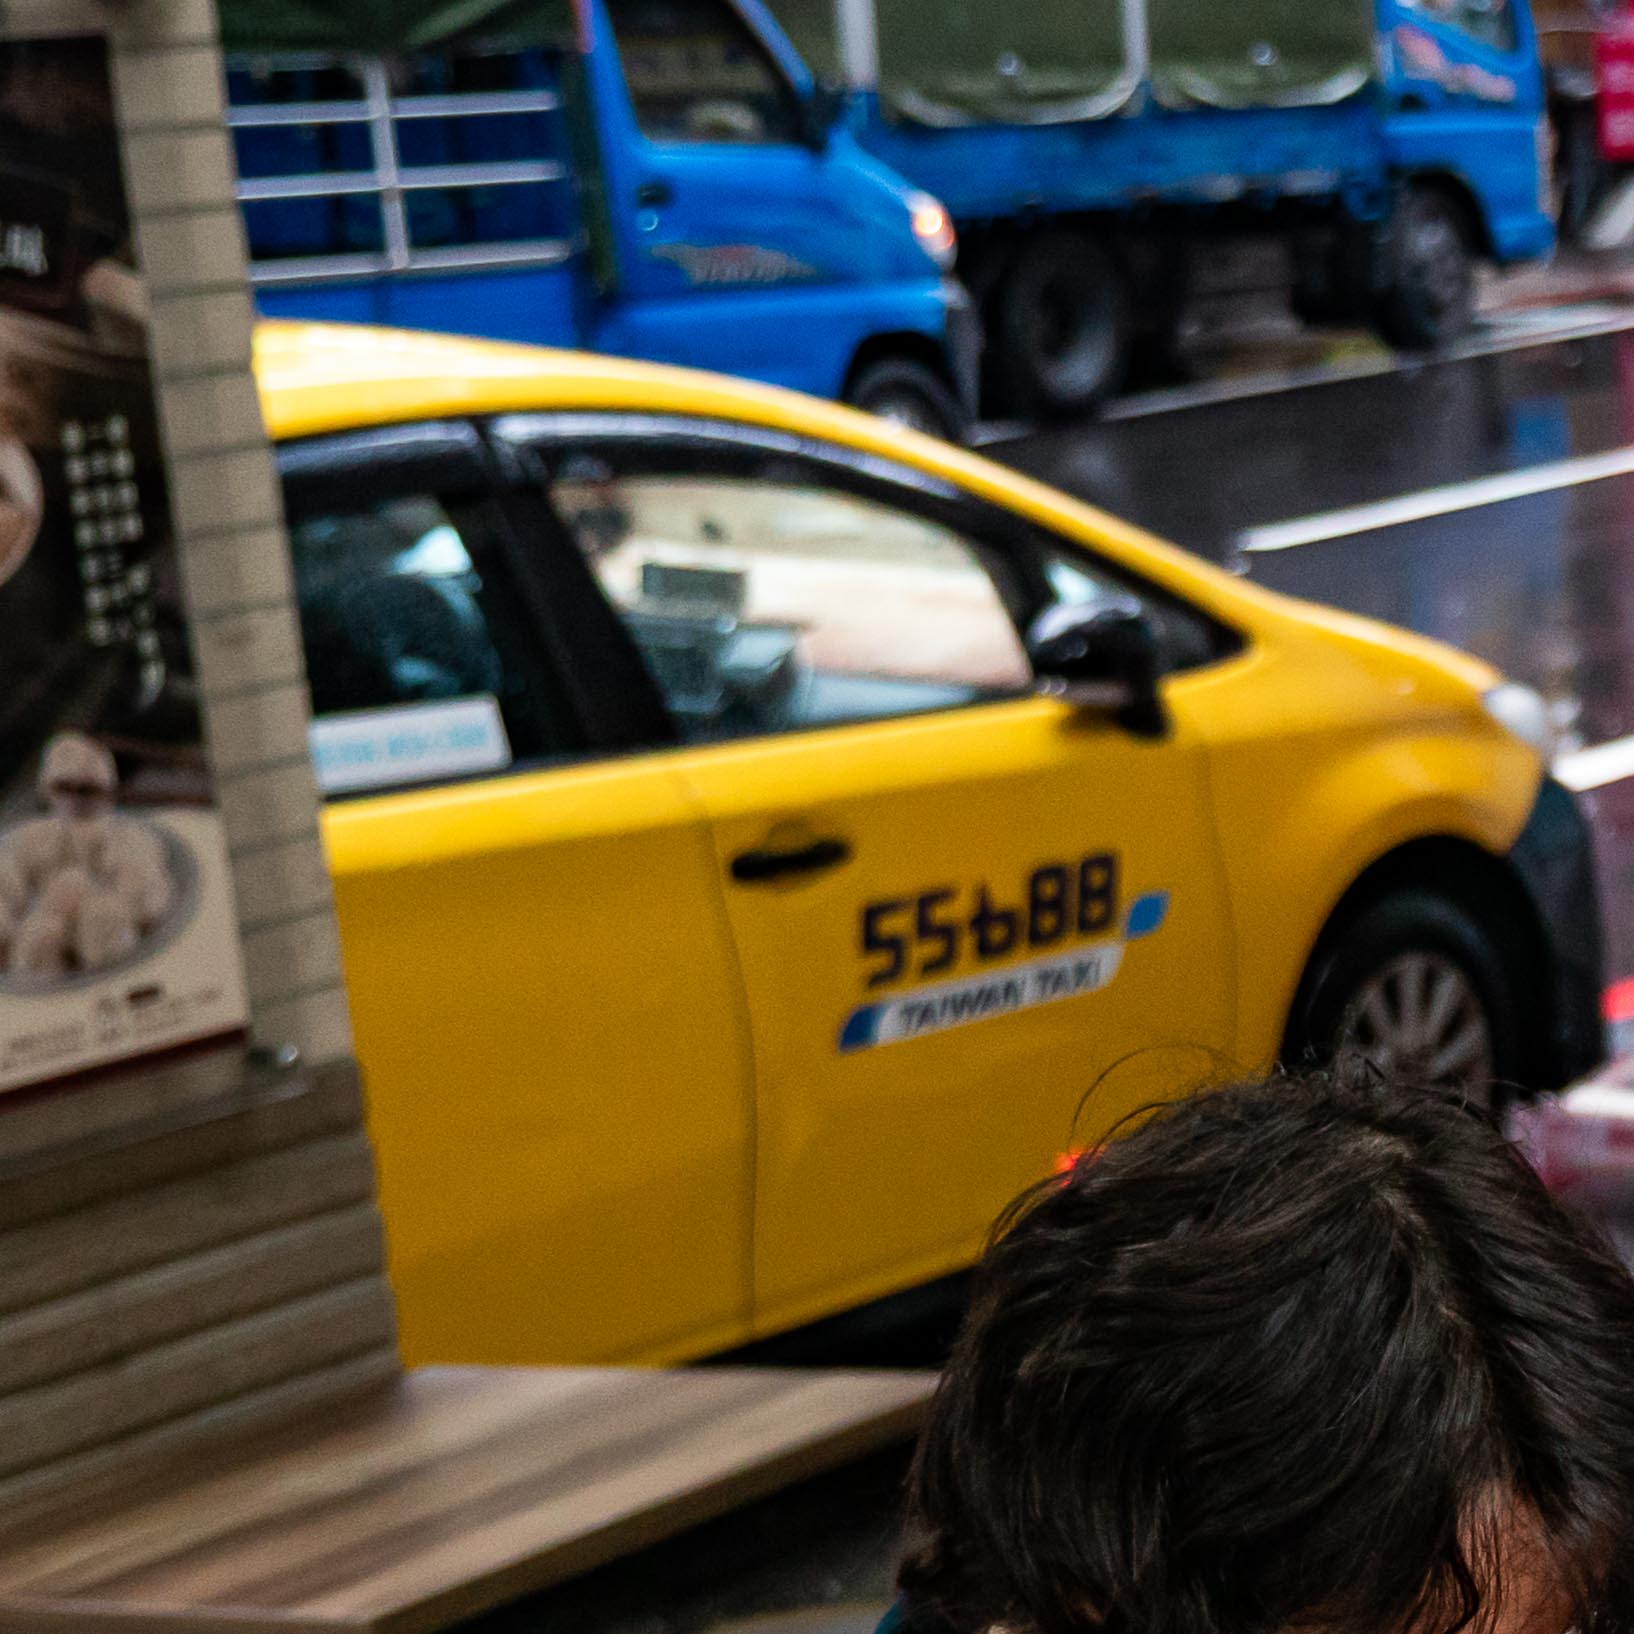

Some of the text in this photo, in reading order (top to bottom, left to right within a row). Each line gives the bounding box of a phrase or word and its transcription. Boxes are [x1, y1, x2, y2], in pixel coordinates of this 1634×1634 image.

[861, 852, 1118, 986] 55688
[900, 959, 1101, 1030] TAIWAN TAXI
